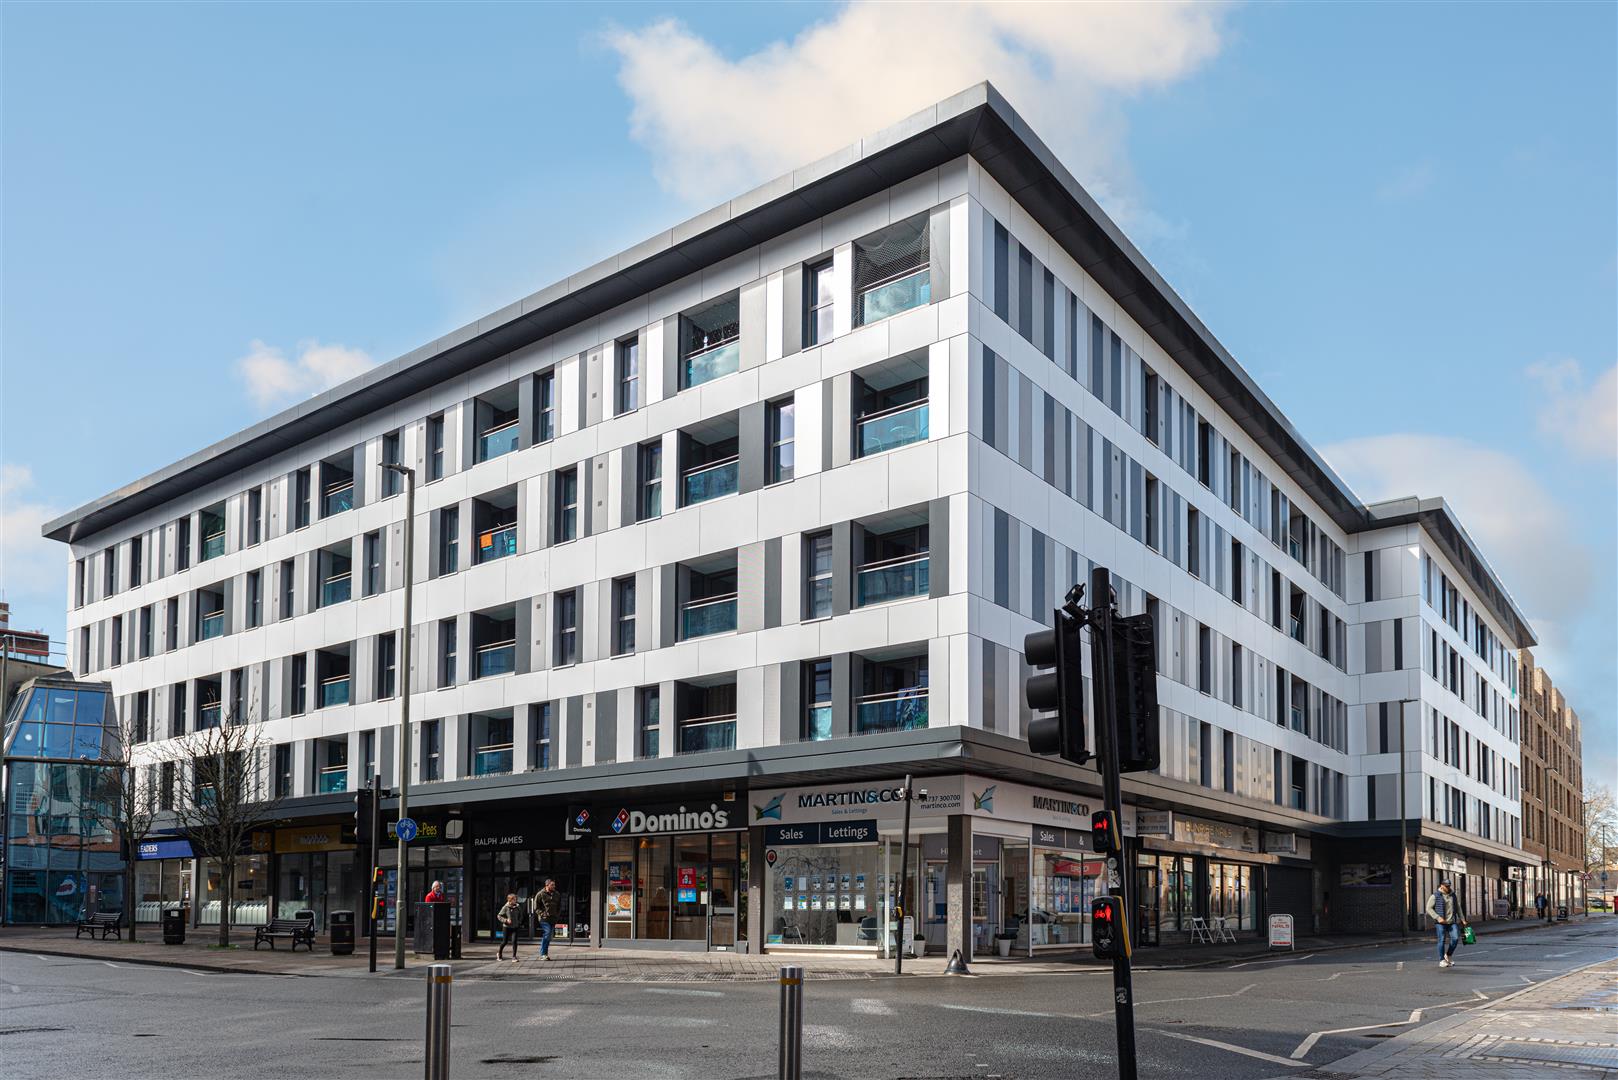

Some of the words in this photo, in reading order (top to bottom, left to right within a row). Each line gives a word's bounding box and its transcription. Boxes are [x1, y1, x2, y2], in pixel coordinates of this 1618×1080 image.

[940, 794, 960, 802] 300700
[920, 801, 960, 810] martinco.com
[1033, 795, 1089, 817] MARTIN&CO
[629, 803, 729, 833] Domino's
[779, 828, 804, 840] Sales
[828, 826, 868, 840] Lettings
[1040, 830, 1055, 843] Sales
[474, 837, 498, 846] RALPH
[499, 835, 524, 844] JAMES
